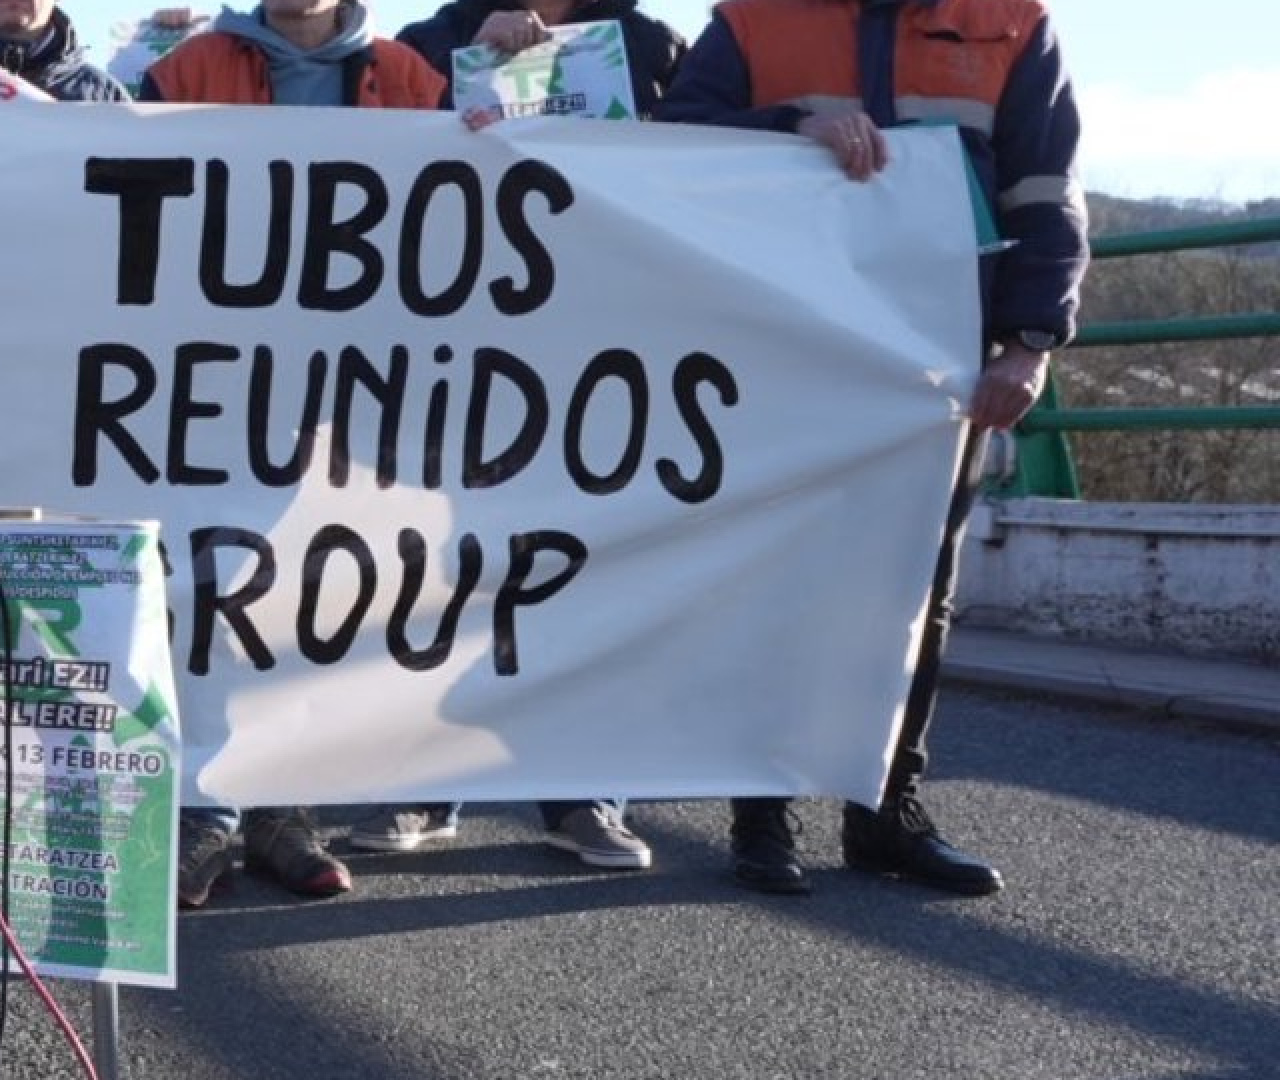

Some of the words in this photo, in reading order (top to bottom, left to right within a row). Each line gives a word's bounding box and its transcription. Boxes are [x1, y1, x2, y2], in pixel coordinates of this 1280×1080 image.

[84, 157, 575, 318] TUBOS
[158, 522, 589, 677] ROUP
[49, 659, 110, 692] EZ!!
[35, 701, 117, 732] ERE!!
[17, 743, 44, 765] 13
[52, 747, 161, 774] FEBRERO
